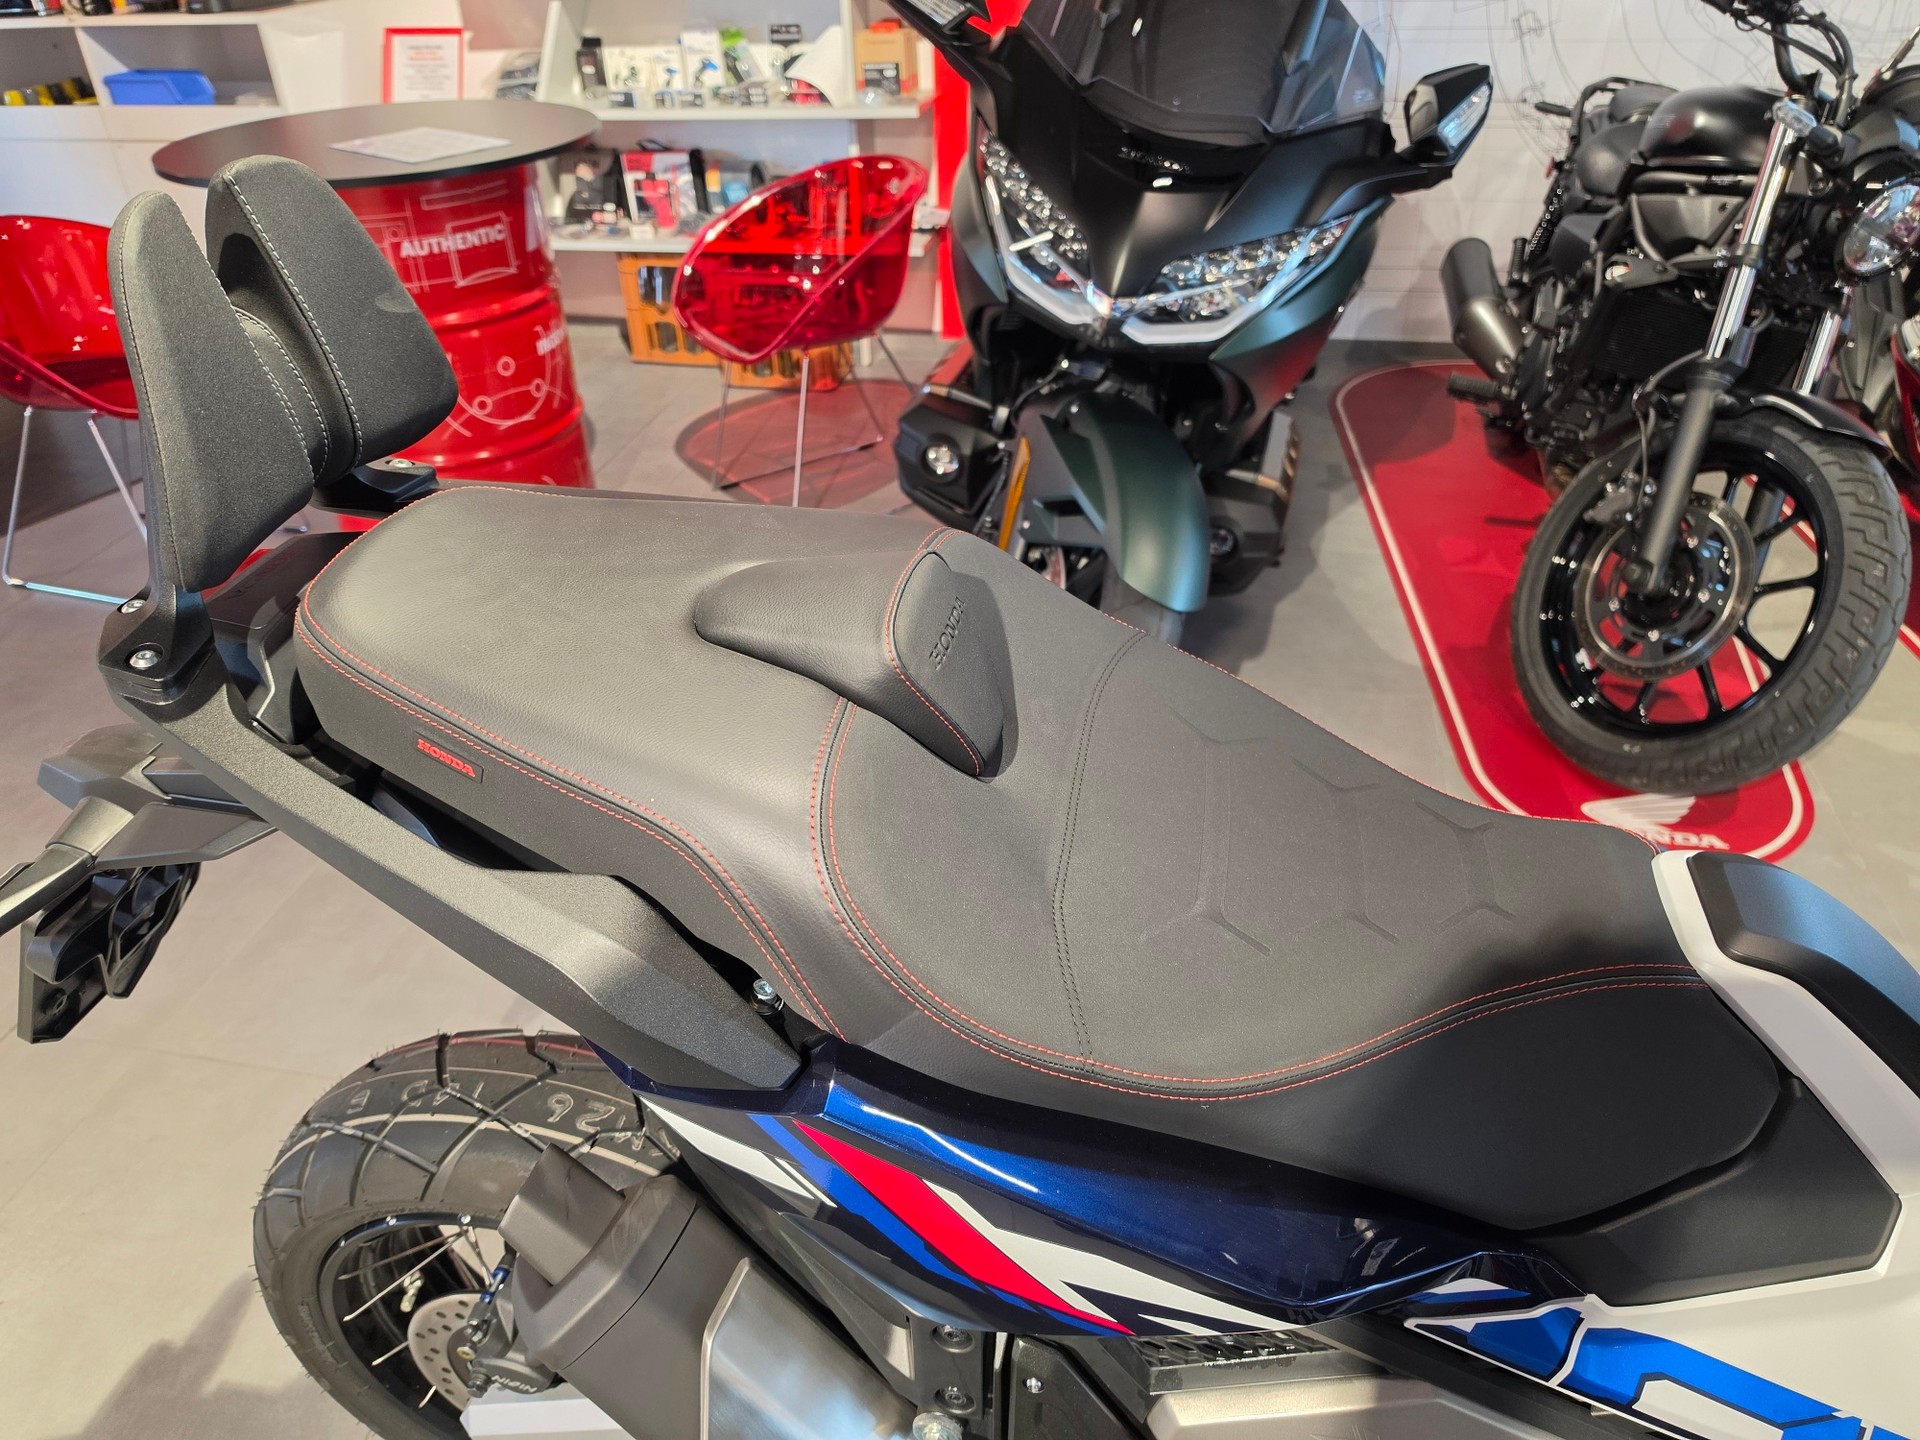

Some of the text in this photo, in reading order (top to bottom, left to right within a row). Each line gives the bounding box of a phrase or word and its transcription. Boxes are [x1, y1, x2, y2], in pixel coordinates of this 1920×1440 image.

[401, 224, 505, 258] AUTHENTIC
[928, 596, 965, 670] HONDA
[417, 738, 476, 778] HONDA
[1644, 826, 1730, 850] NDA
